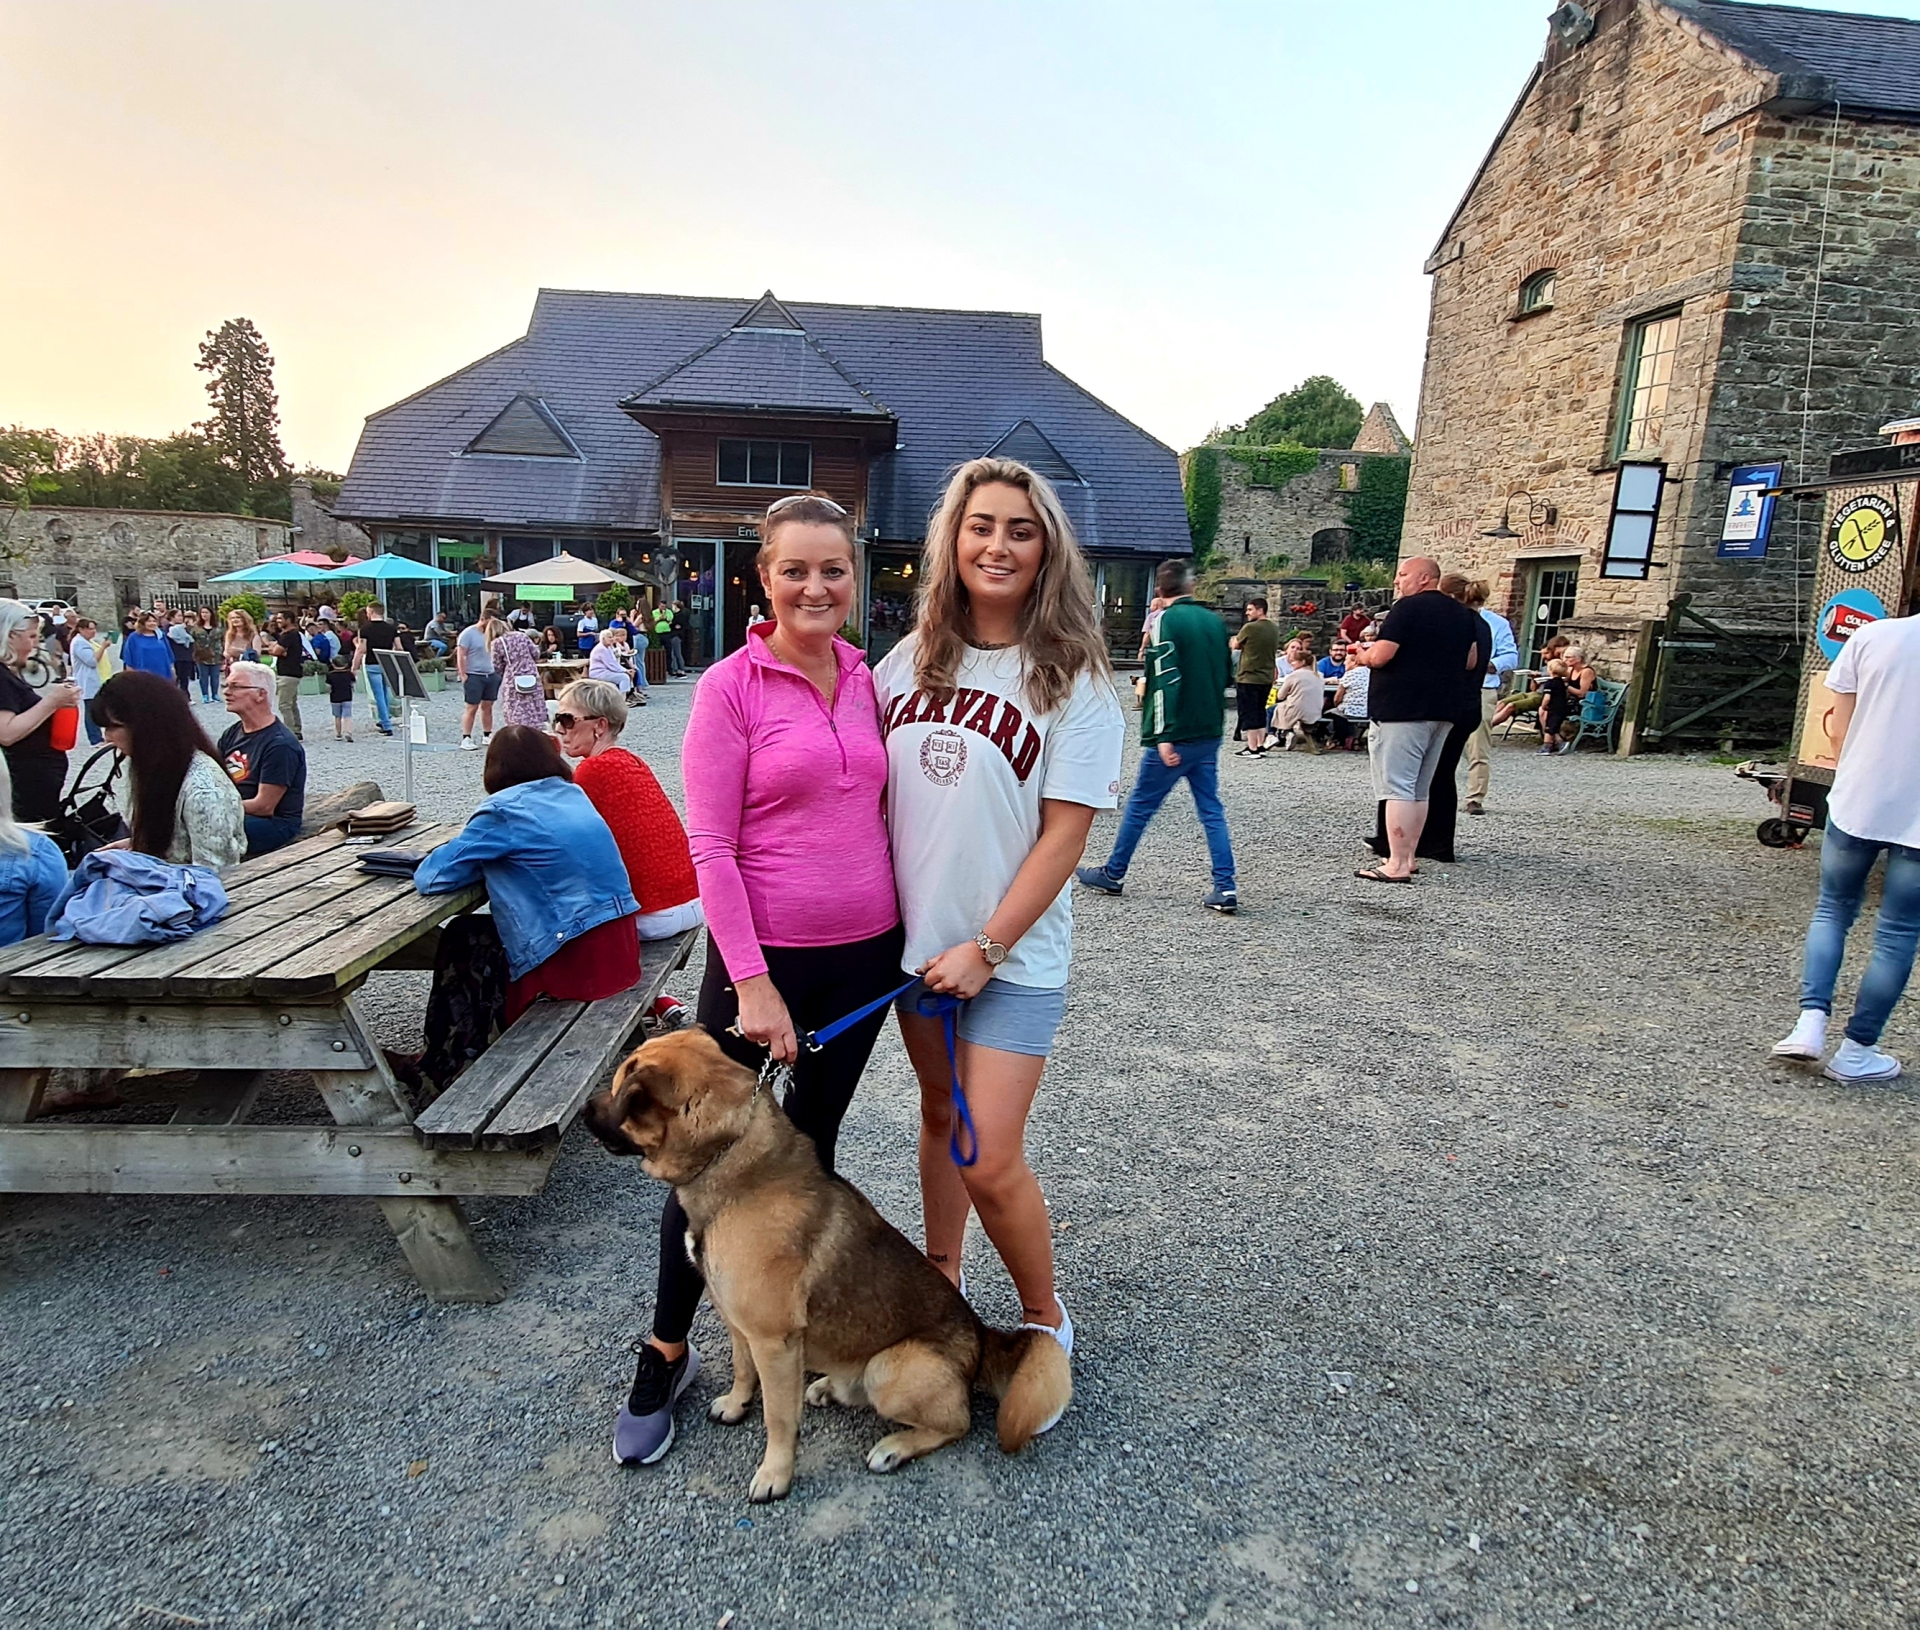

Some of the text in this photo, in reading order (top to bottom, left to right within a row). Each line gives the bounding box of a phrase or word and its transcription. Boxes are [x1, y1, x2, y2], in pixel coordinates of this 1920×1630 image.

[1831, 497, 1896, 529] VEGETARIAN &
[737, 526, 760, 537] Ent
[1829, 539, 1892, 572] GLUTTEN FREE
[881, 687, 1042, 782] HARVARD
